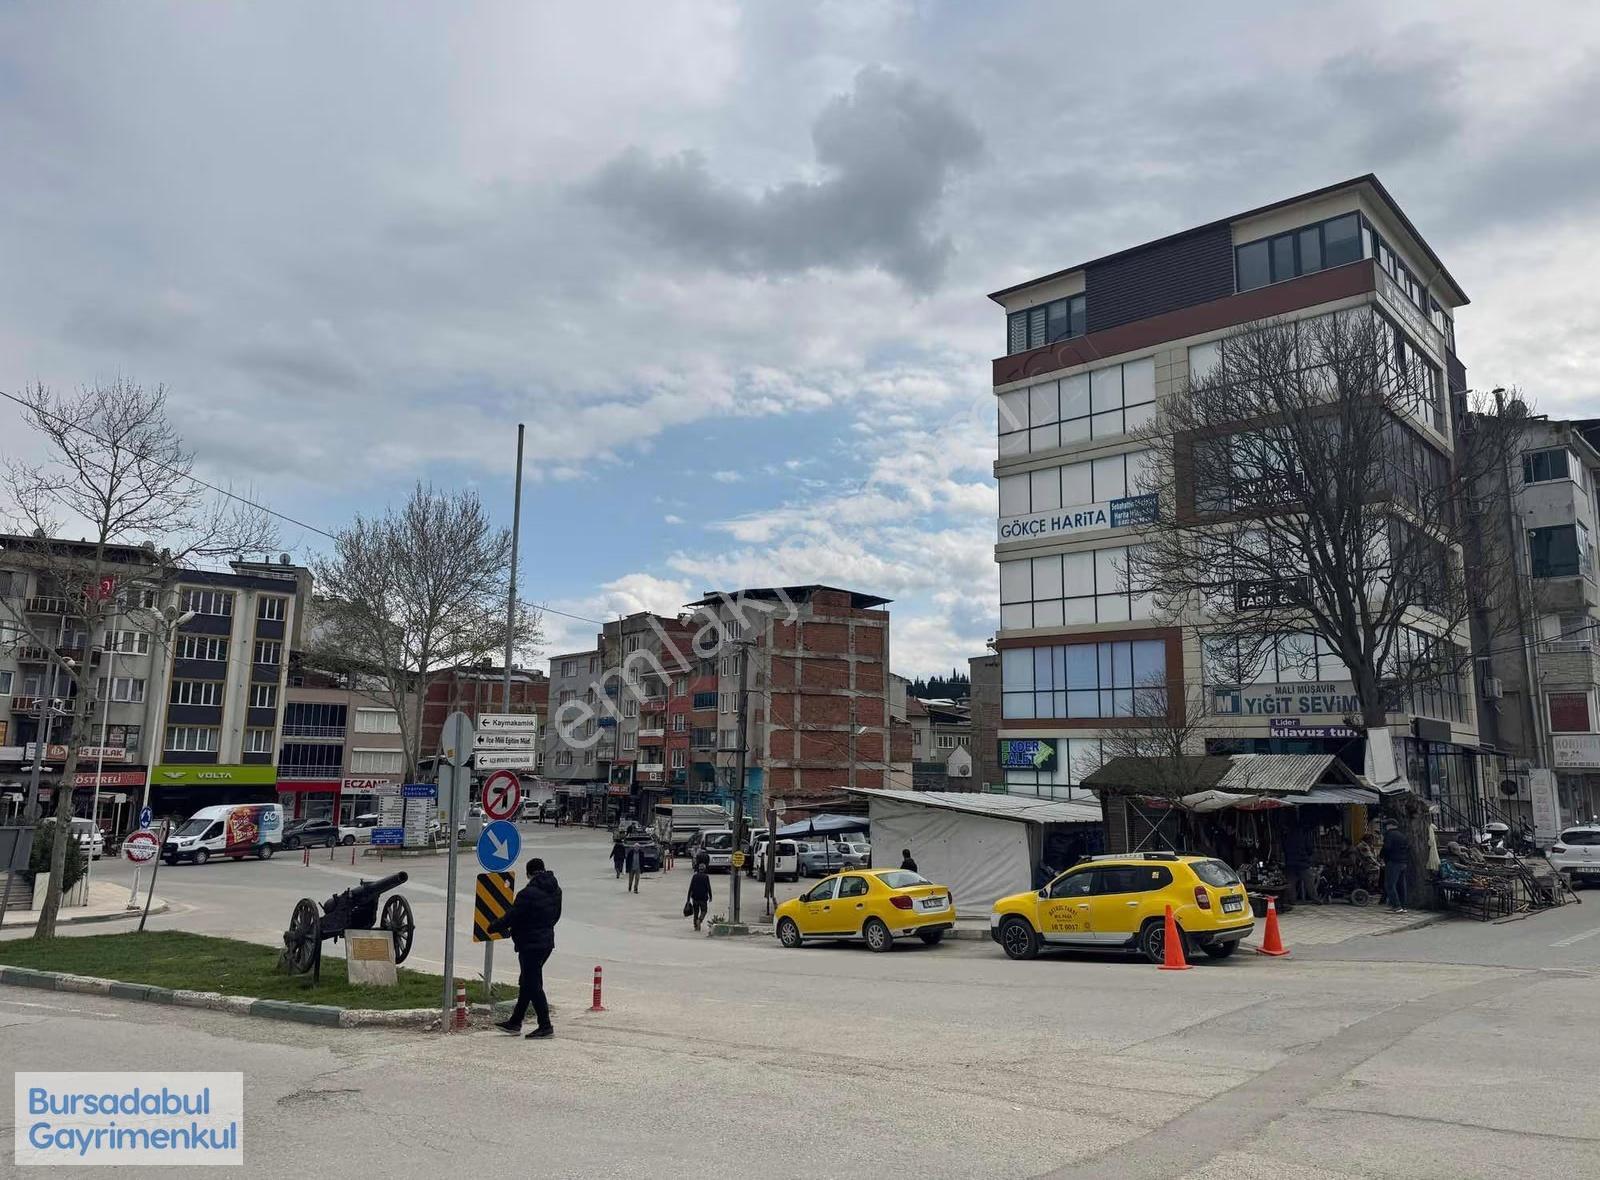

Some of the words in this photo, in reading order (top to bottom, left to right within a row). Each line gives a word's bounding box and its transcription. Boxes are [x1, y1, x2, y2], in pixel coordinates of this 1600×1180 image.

[1001, 519, 1046, 537] GÖKÇE
[1274, 685, 1296, 694] MALİ
[1298, 684, 1336, 695] MÜŞAVİR
[1270, 728, 1325, 738] kılavuz
[344, 779, 388, 789] ECZAN
